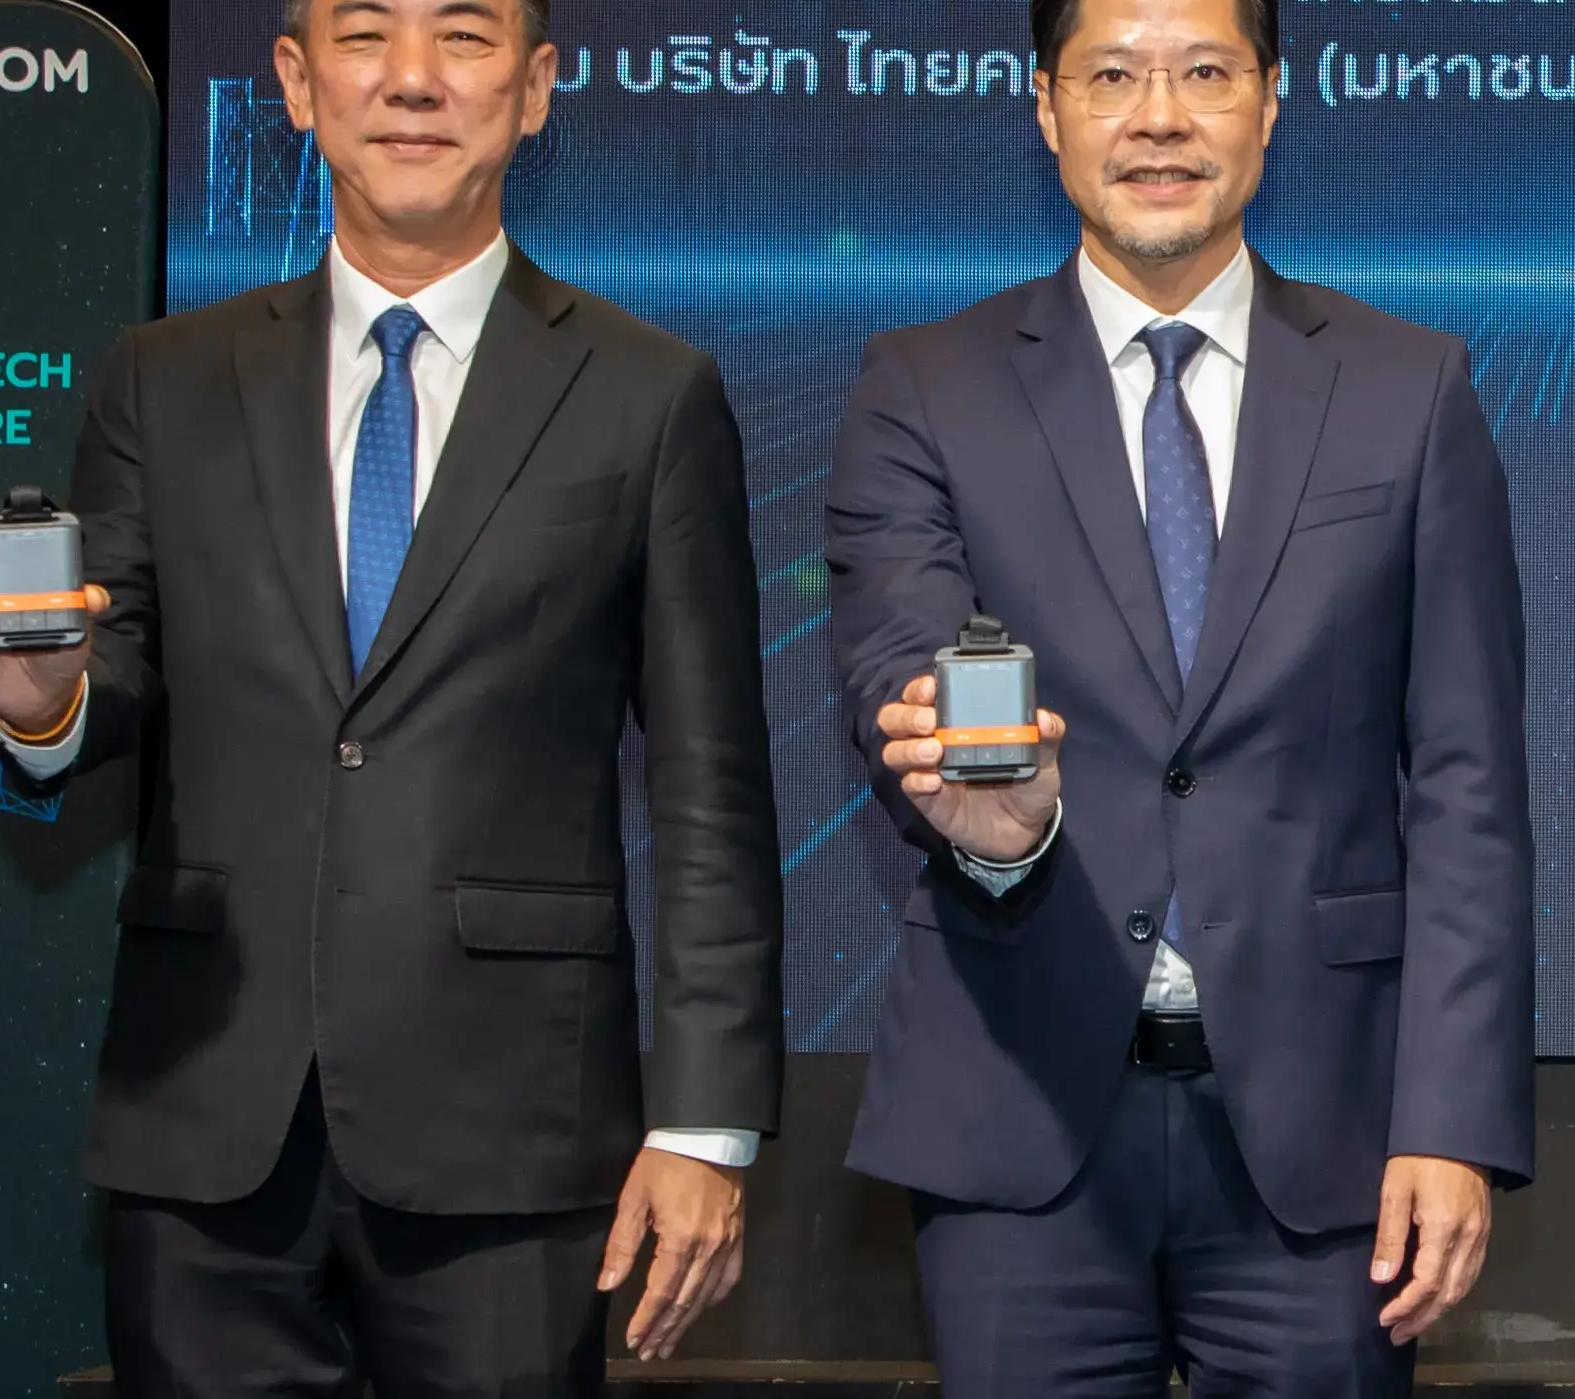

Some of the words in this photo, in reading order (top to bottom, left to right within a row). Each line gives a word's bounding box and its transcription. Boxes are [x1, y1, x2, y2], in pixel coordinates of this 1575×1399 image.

[616, 28, 819, 96] บริษัท
[837, 30, 1037, 97] ไทยค
